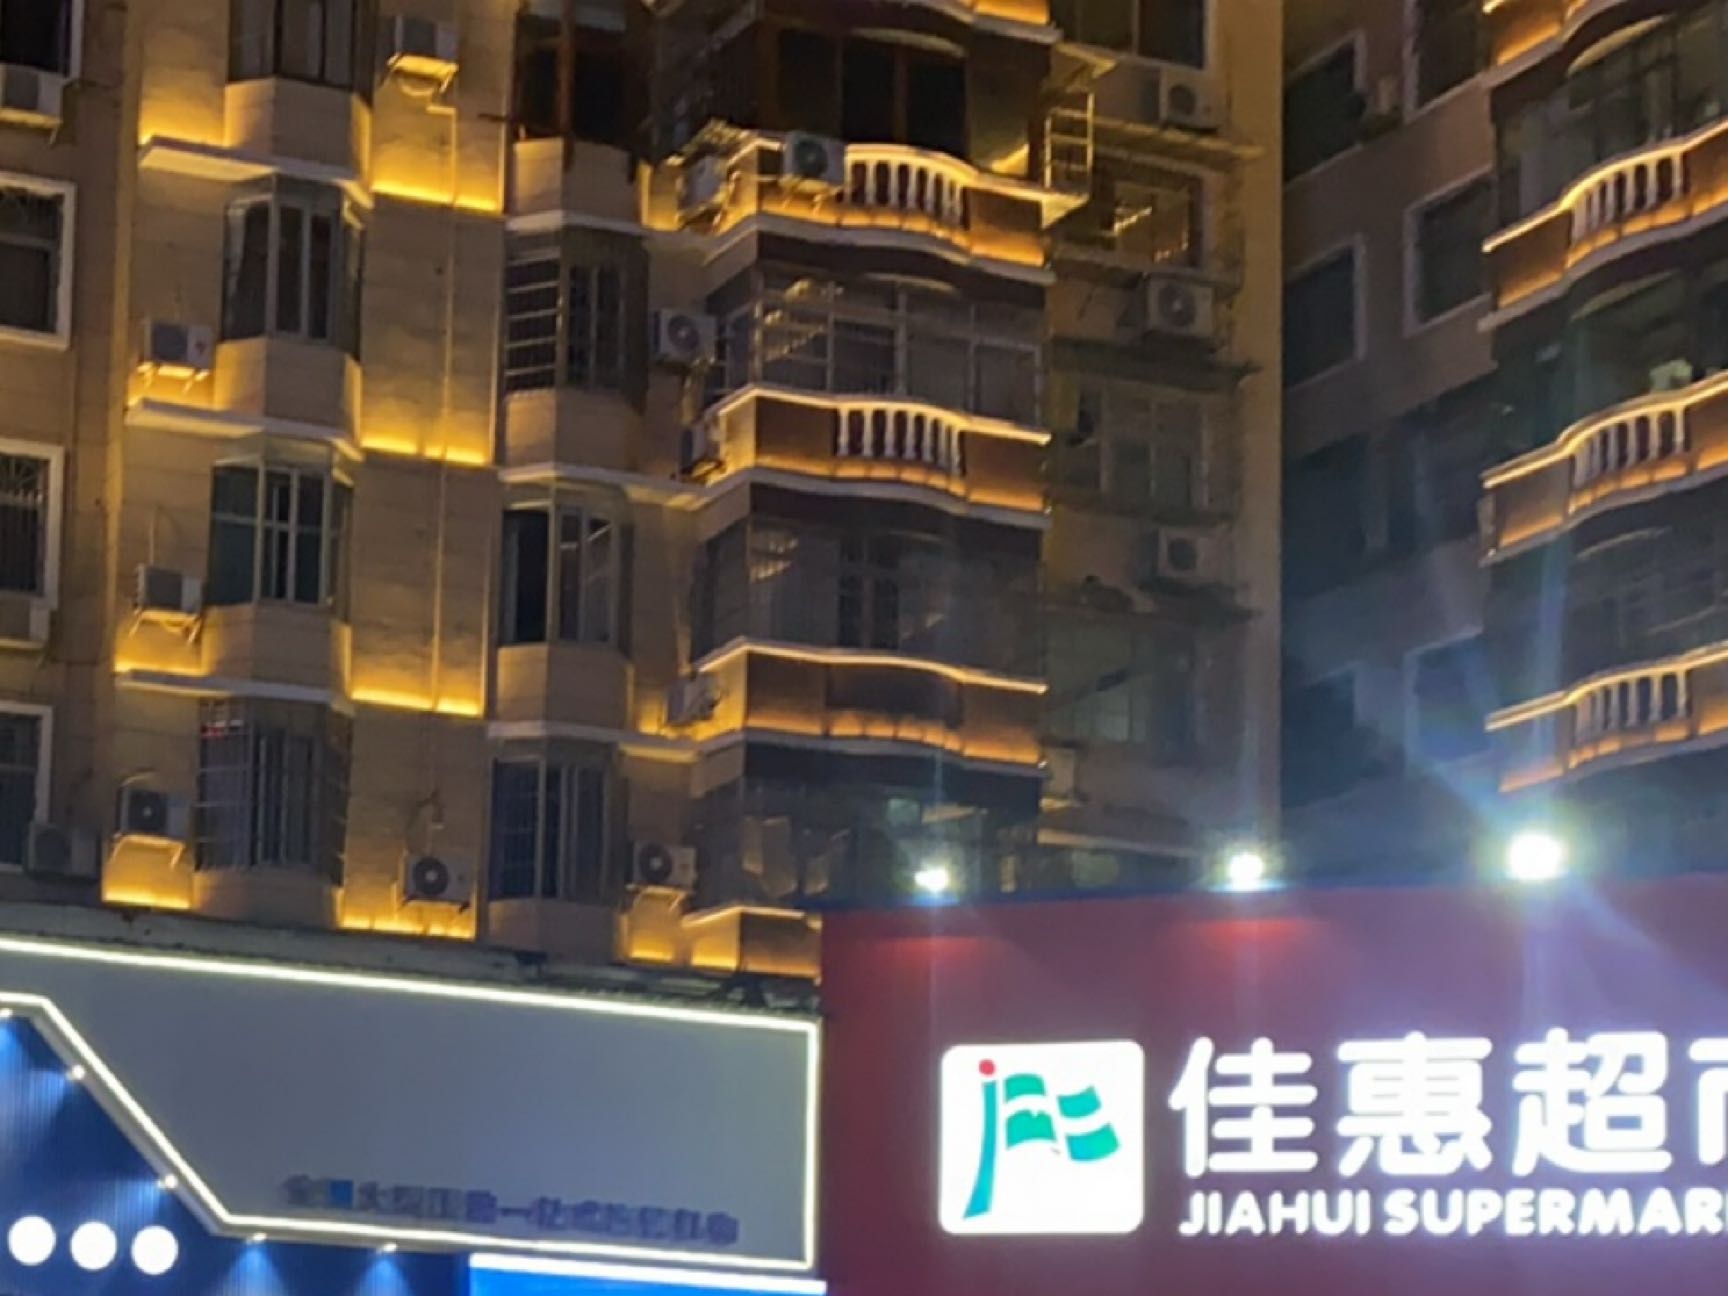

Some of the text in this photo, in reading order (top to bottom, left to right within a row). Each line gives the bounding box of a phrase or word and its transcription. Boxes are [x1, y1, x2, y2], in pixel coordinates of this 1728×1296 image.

[1170, 1027, 1728, 1177] 佳惠超
[1178, 1187, 1728, 1237] JIAHUI SUPERMAR
